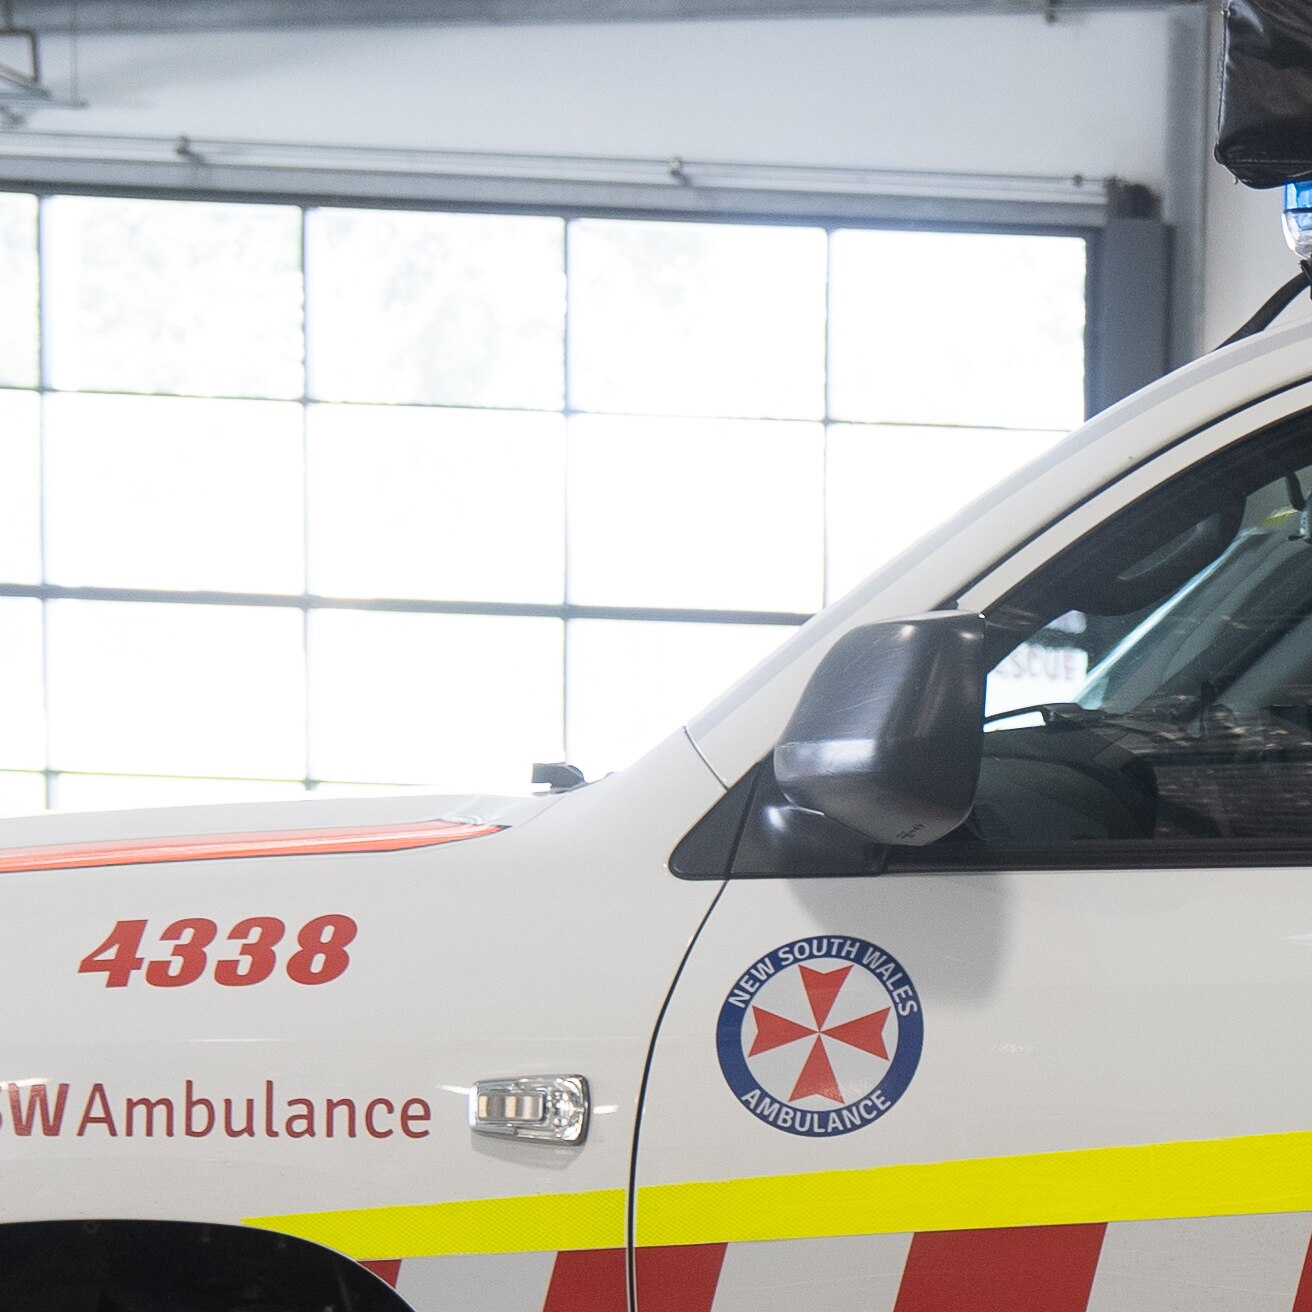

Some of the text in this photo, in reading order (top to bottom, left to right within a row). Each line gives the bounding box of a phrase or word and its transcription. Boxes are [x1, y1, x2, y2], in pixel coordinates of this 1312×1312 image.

[77, 914, 359, 989] 4338
[727, 937, 919, 1018] NEW SOUTH WALES
[741, 1088, 892, 1134] AMBULANCE
